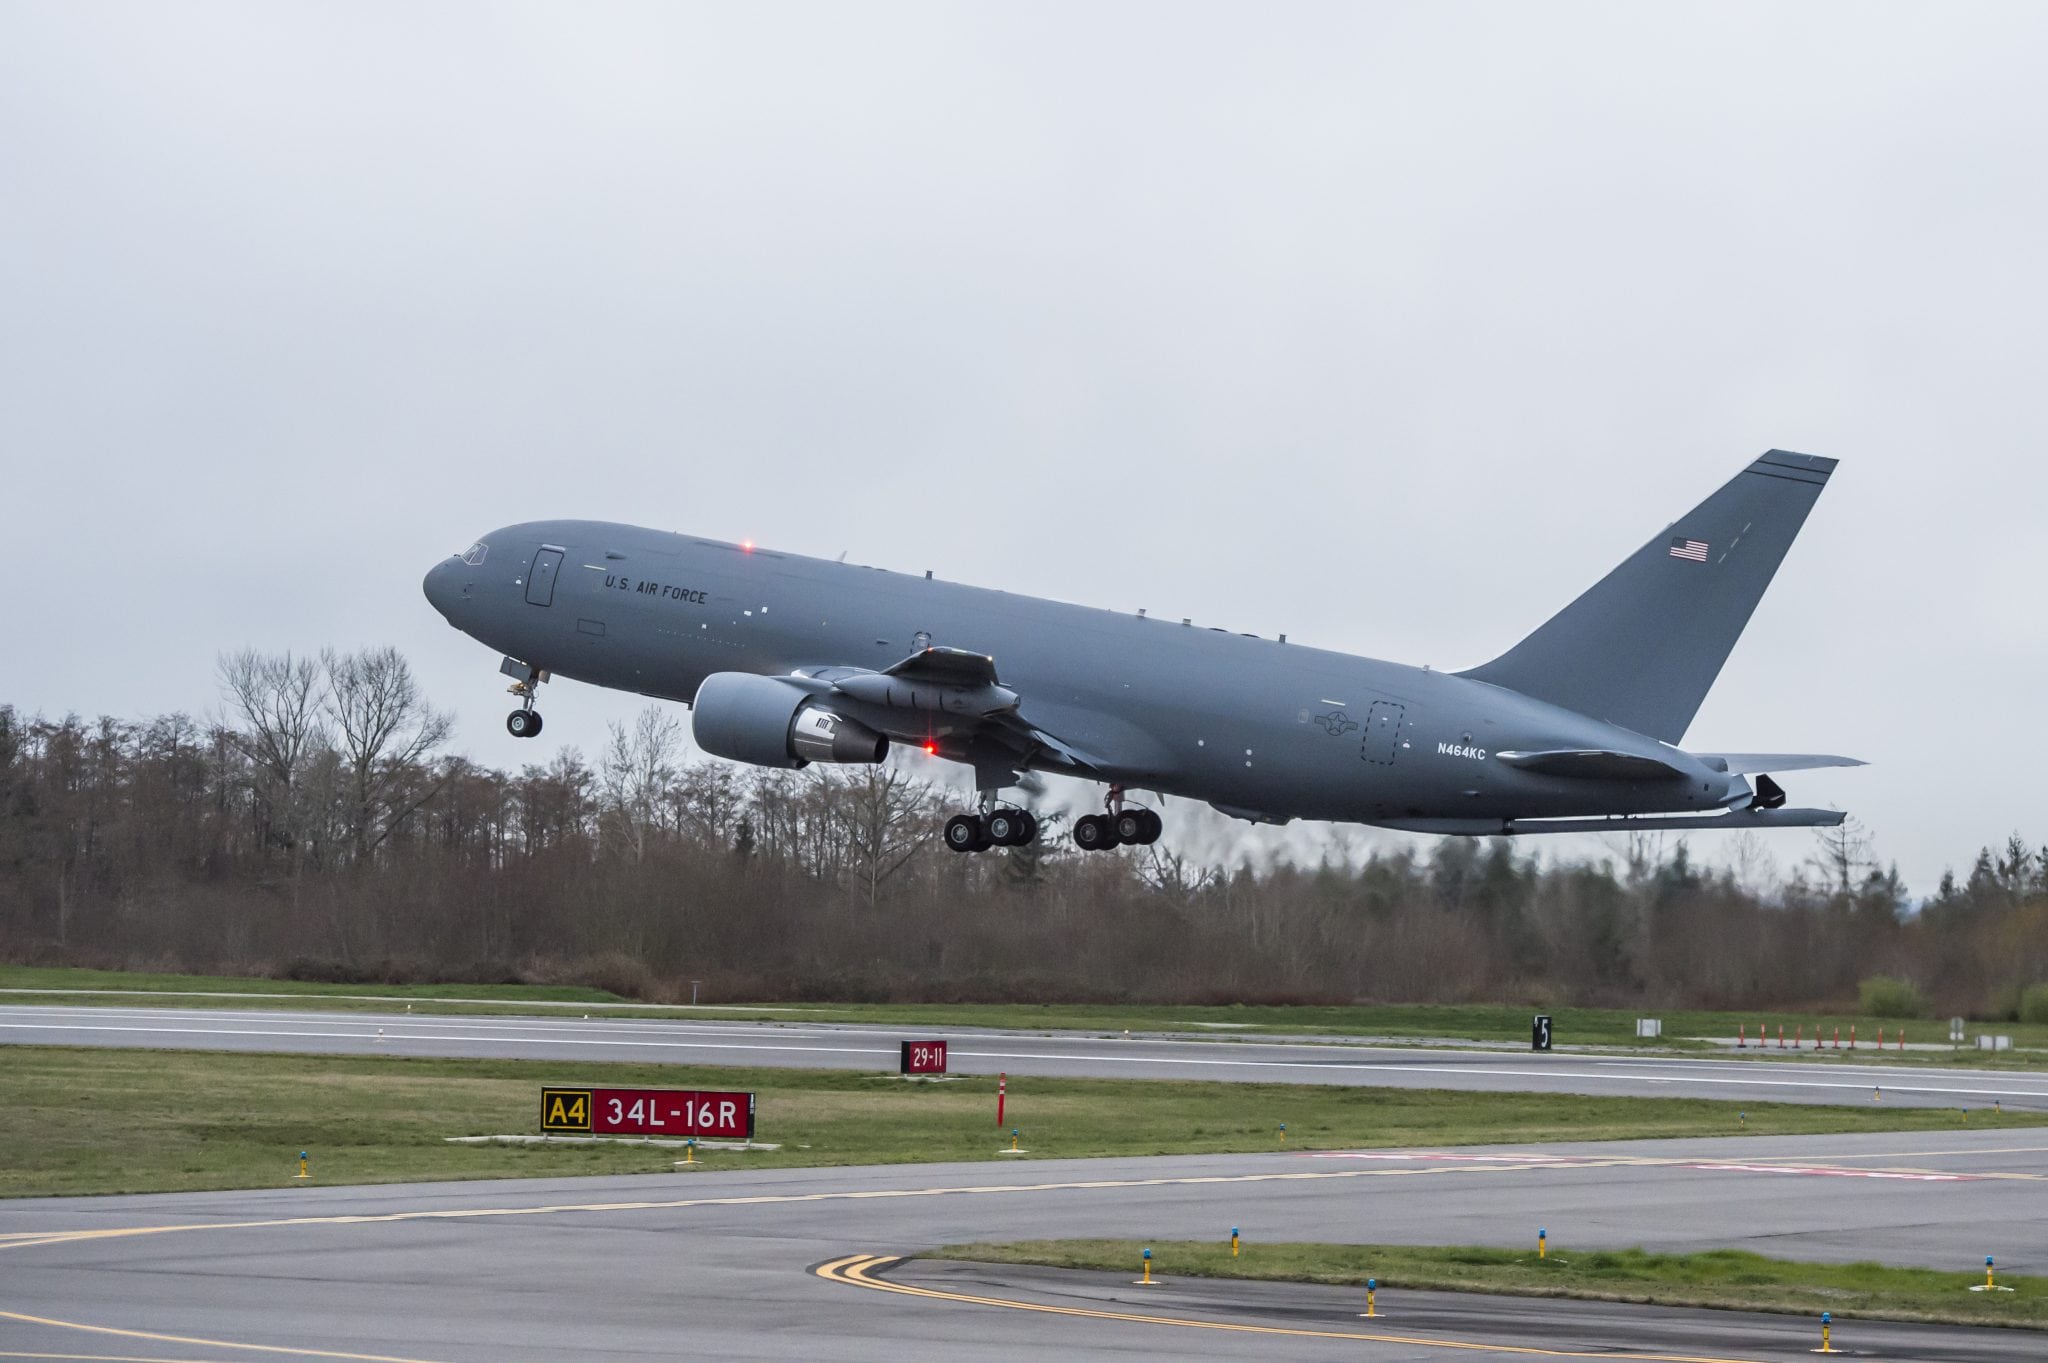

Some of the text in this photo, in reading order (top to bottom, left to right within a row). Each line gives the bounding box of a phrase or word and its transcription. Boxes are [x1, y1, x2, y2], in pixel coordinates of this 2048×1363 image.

[605, 575, 708, 605] U.S. AIR FORCE
[1437, 742, 1486, 760] N464KC
[1541, 1018, 1549, 1048] 5
[913, 1047, 942, 1067] 29-11
[549, 1097, 585, 1124] A4
[607, 1098, 736, 1128] 34L-16R
